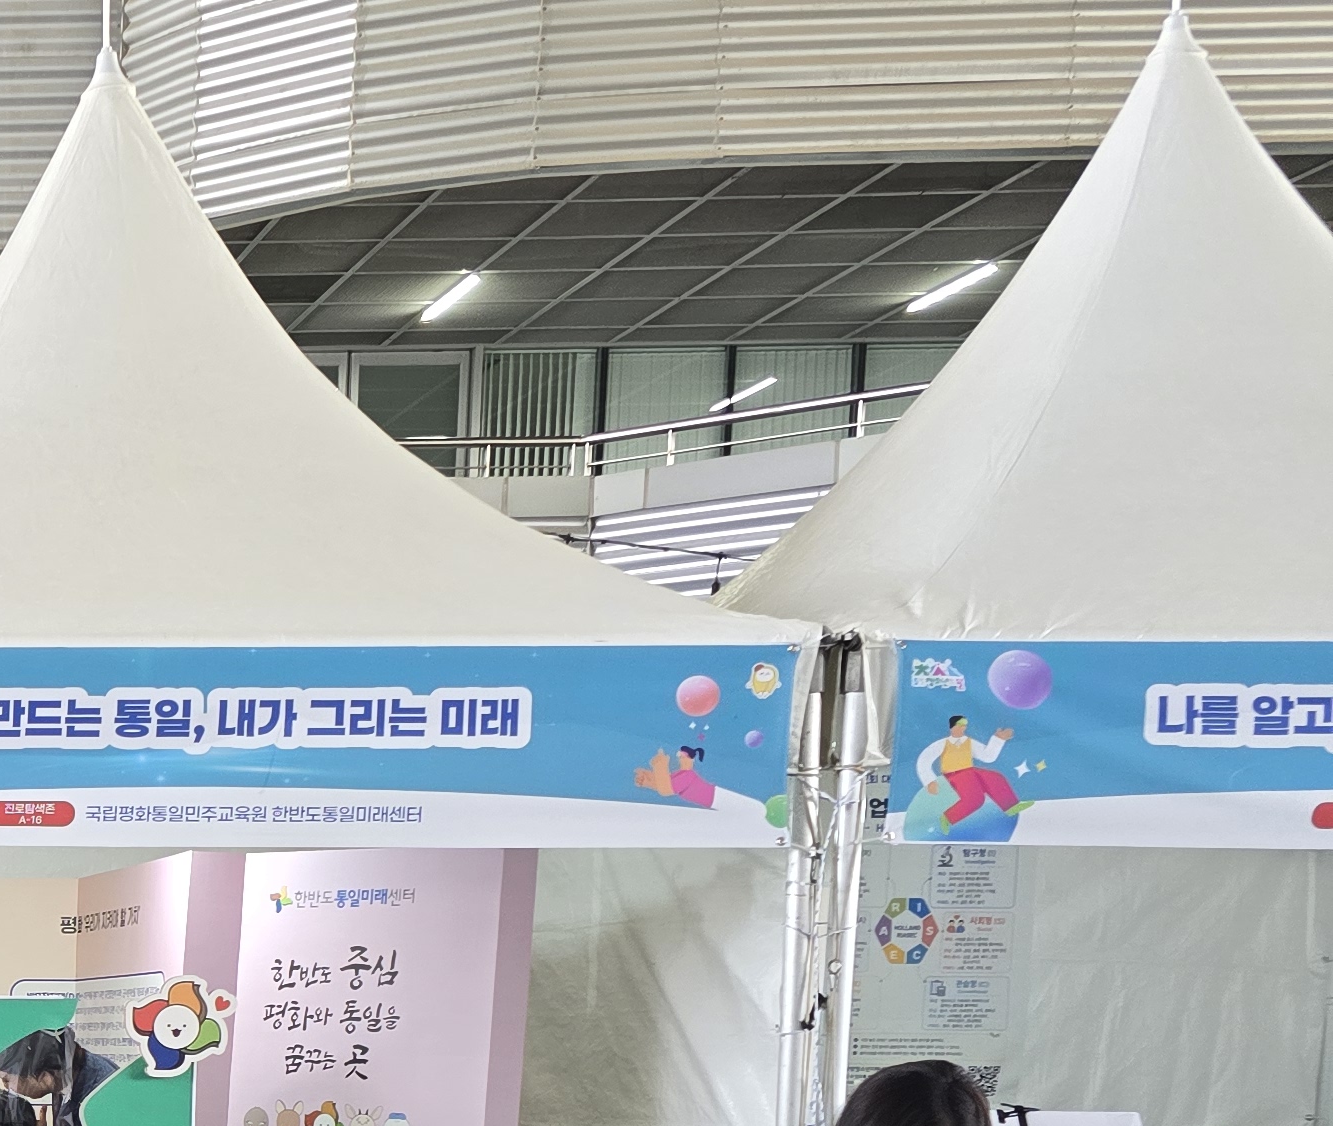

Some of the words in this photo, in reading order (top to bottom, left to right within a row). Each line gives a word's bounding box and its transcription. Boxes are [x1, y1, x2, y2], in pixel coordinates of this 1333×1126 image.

[113, 699, 206, 745] 통일,
[216, 699, 298, 739] 내가
[306, 698, 429, 739] 그리는
[440, 698, 520, 739] 미래
[1156, 695, 1240, 735] 나를
[1252, 695, 1333, 736] 알고
[4, 803, 56, 815] 진로탐색존
[18, 815, 42, 825] A-16
[85, 805, 268, 824] 국립평화통일민주교육원
[271, 805, 423, 825] 한반도통일미래센터
[294, 888, 416, 909] 한반도통일미래센터
[270, 958, 332, 990] 한반도
[340, 945, 400, 991] 중심
[263, 1000, 333, 1031] 평화와
[339, 1000, 401, 1034] 통일을
[285, 1043, 337, 1075] 꿈꾸는
[344, 1043, 370, 1081] 곳
